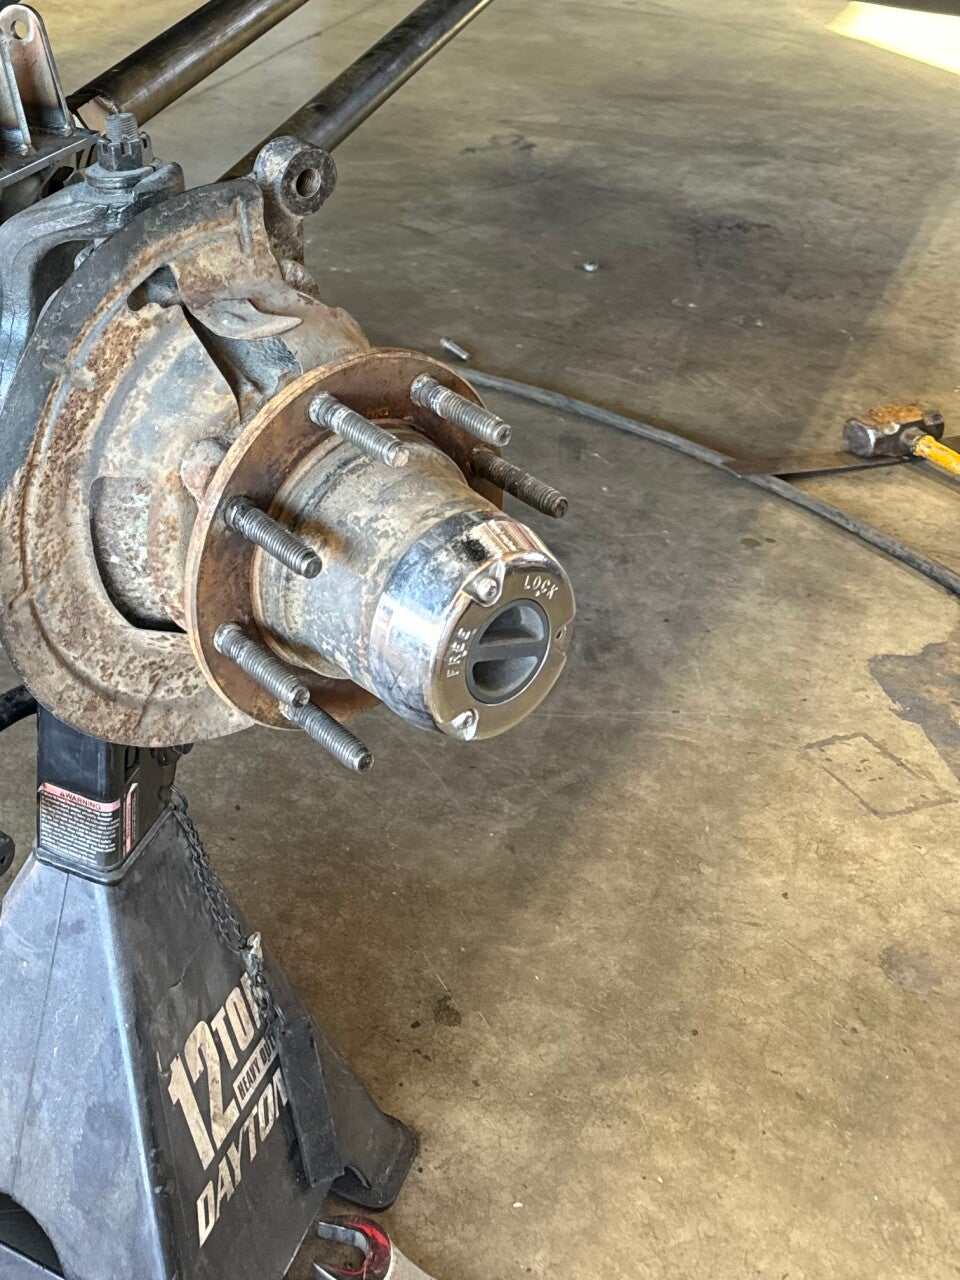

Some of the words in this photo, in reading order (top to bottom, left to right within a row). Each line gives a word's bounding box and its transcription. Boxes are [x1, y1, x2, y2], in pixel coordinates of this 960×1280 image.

[524, 574, 559, 600] LOCK
[446, 627, 471, 678] FREE
[66, 792, 101, 810] WARNING
[167, 1020, 240, 1171] 12
[237, 1057, 260, 1101] HEAVY
[196, 1067, 288, 1248] DAYTON
